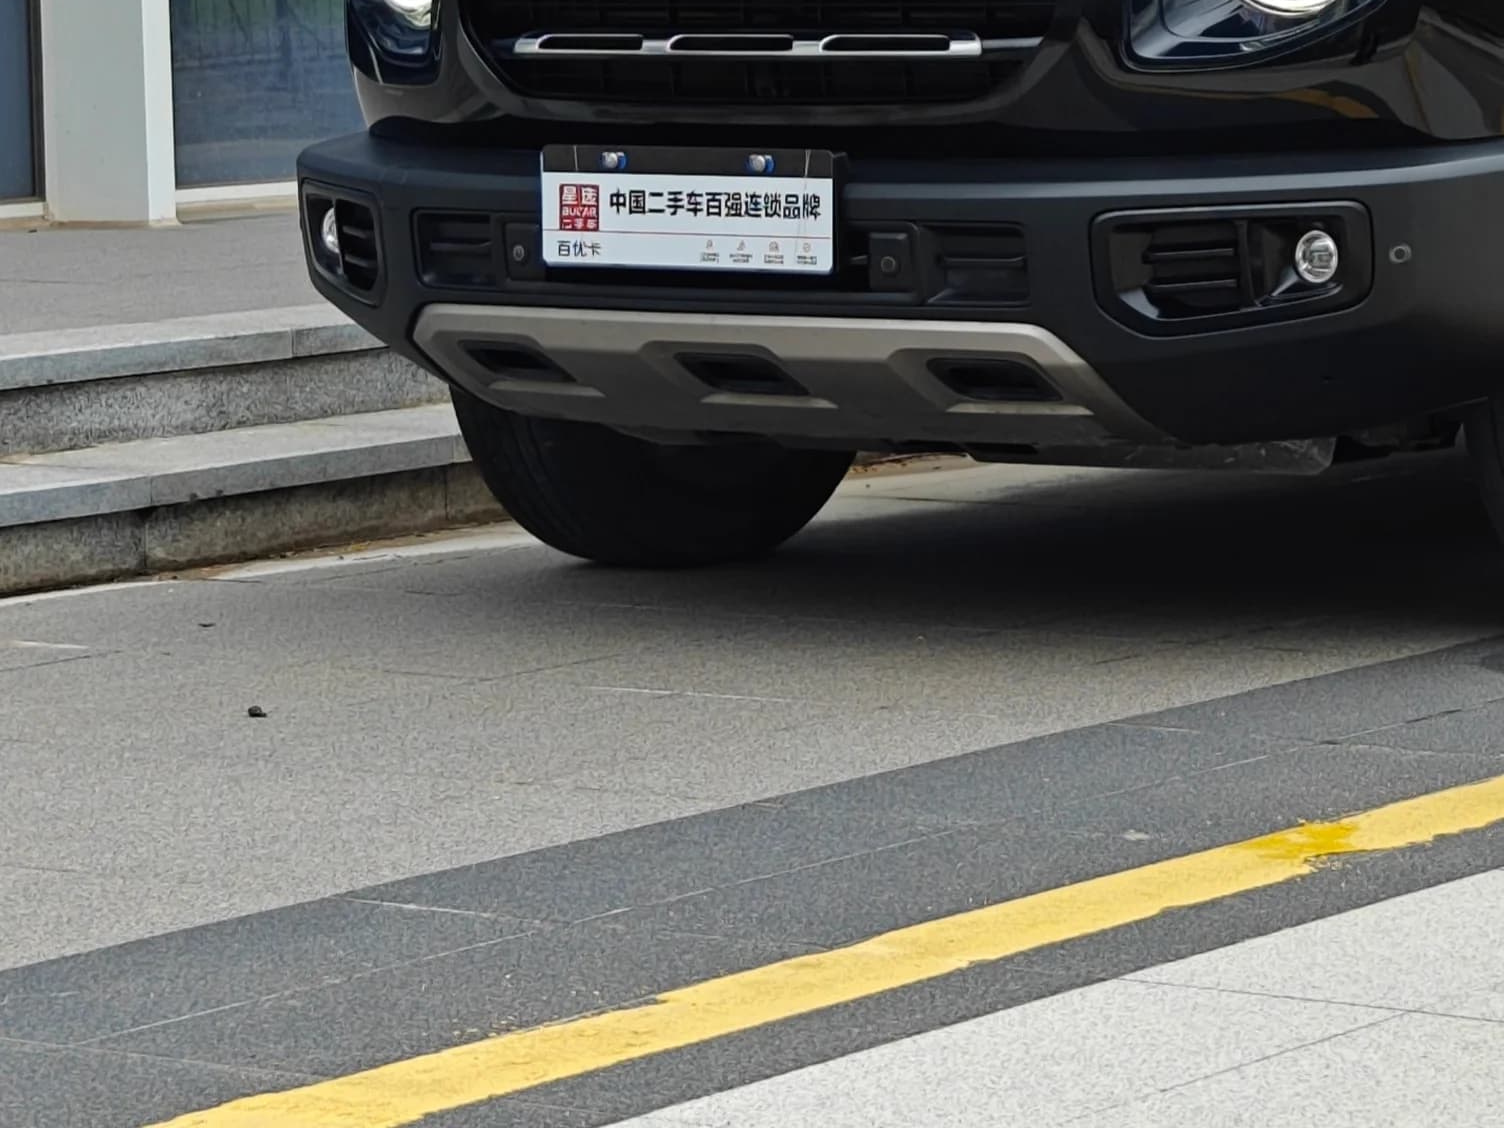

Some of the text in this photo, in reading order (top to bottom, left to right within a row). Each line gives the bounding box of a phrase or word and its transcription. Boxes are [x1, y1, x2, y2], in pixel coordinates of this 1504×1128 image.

[609, 188, 822, 220] 中国二手车百强连锁品牌
[557, 240, 602, 258] 百优卡
